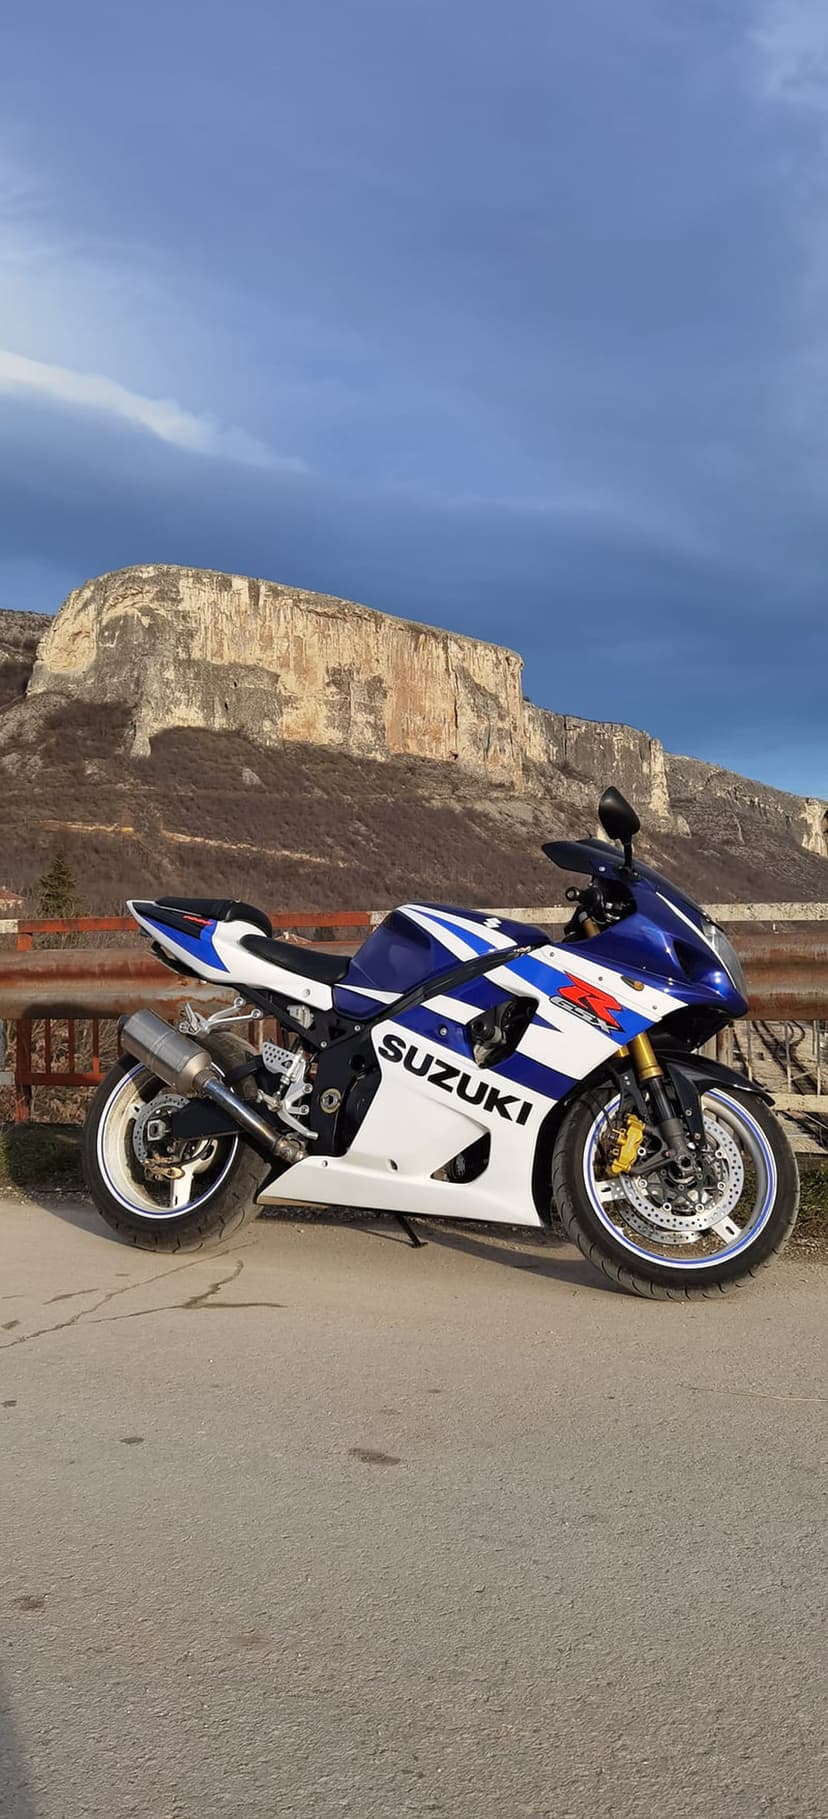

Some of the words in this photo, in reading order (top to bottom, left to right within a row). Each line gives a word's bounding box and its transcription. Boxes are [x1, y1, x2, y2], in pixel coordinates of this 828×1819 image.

[549, 995, 618, 1034] GSX
[558, 971, 623, 1030] R
[378, 1034, 533, 1126] SUZUKI
